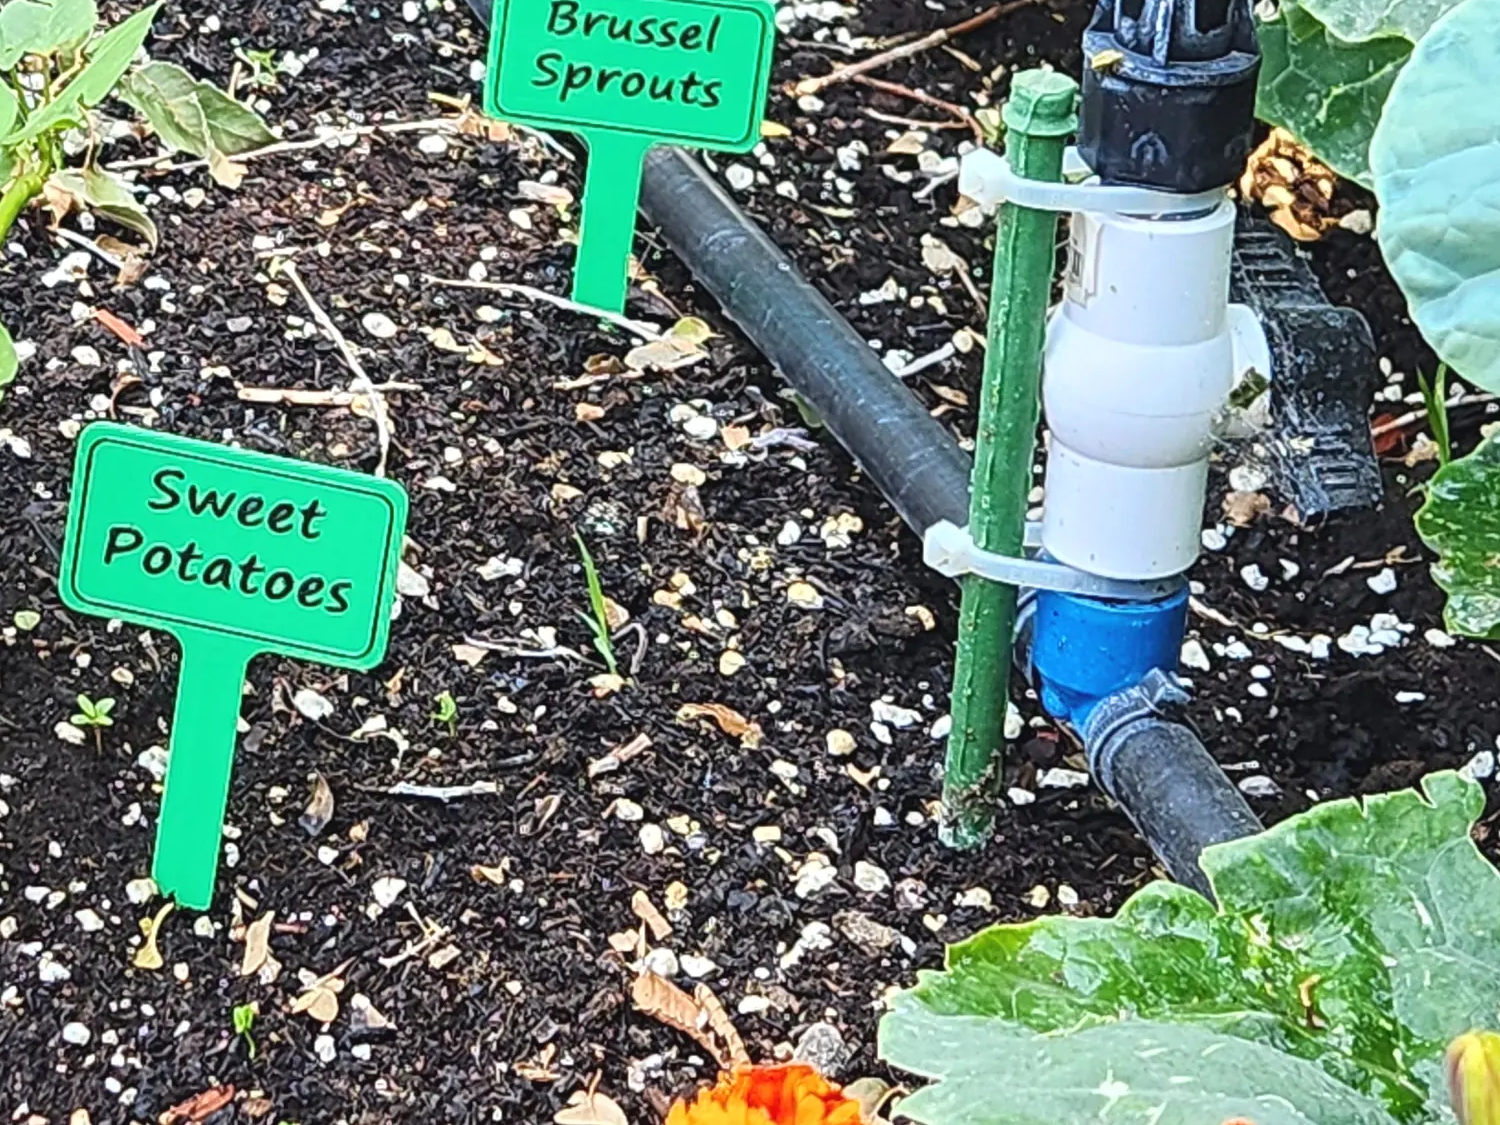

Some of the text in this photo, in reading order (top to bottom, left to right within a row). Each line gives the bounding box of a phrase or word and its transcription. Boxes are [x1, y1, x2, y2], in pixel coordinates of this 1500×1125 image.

[547, 0, 721, 53] Brussel
[531, 52, 722, 108] Sprouts
[147, 469, 326, 540] Sweet
[103, 526, 352, 613] Potatoes
